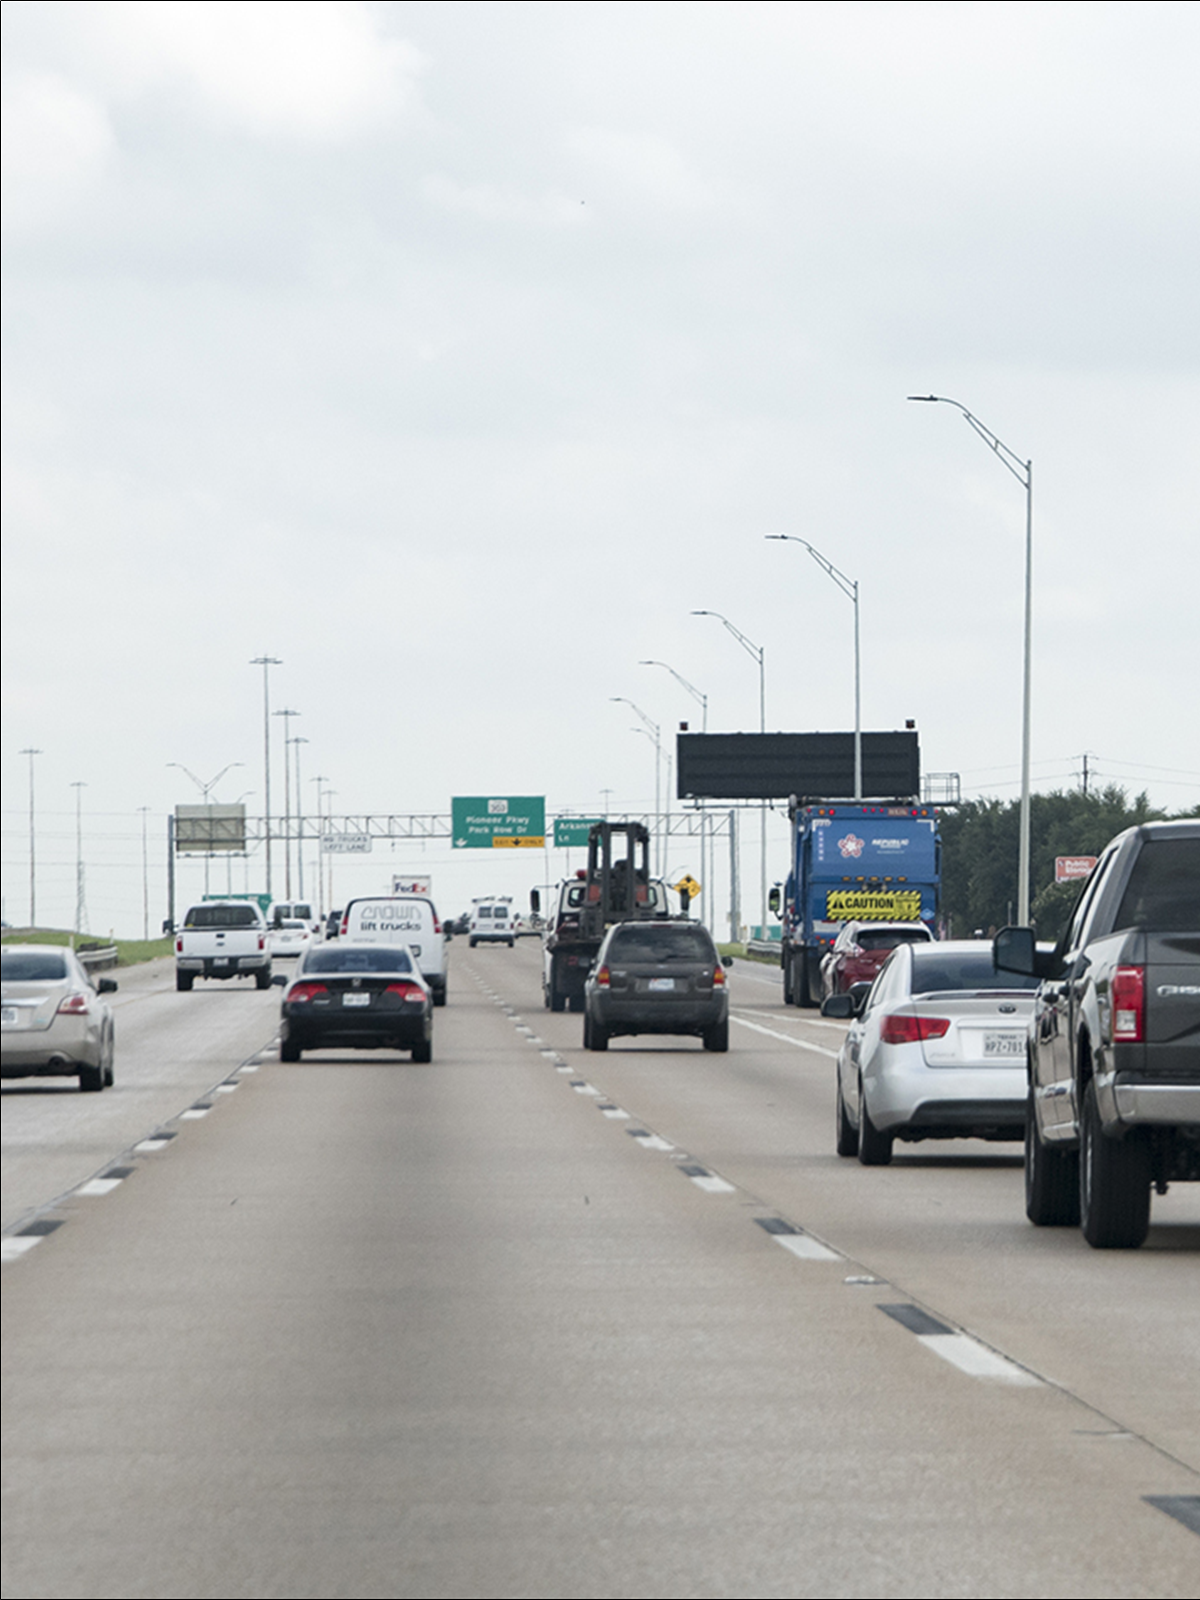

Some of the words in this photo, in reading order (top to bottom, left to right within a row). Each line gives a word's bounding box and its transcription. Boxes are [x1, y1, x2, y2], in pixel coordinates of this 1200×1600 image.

[394, 882, 427, 893] FedEx
[845, 897, 894, 909] CAUTION
[361, 921, 376, 931] lift
[380, 920, 422, 931] trucks
